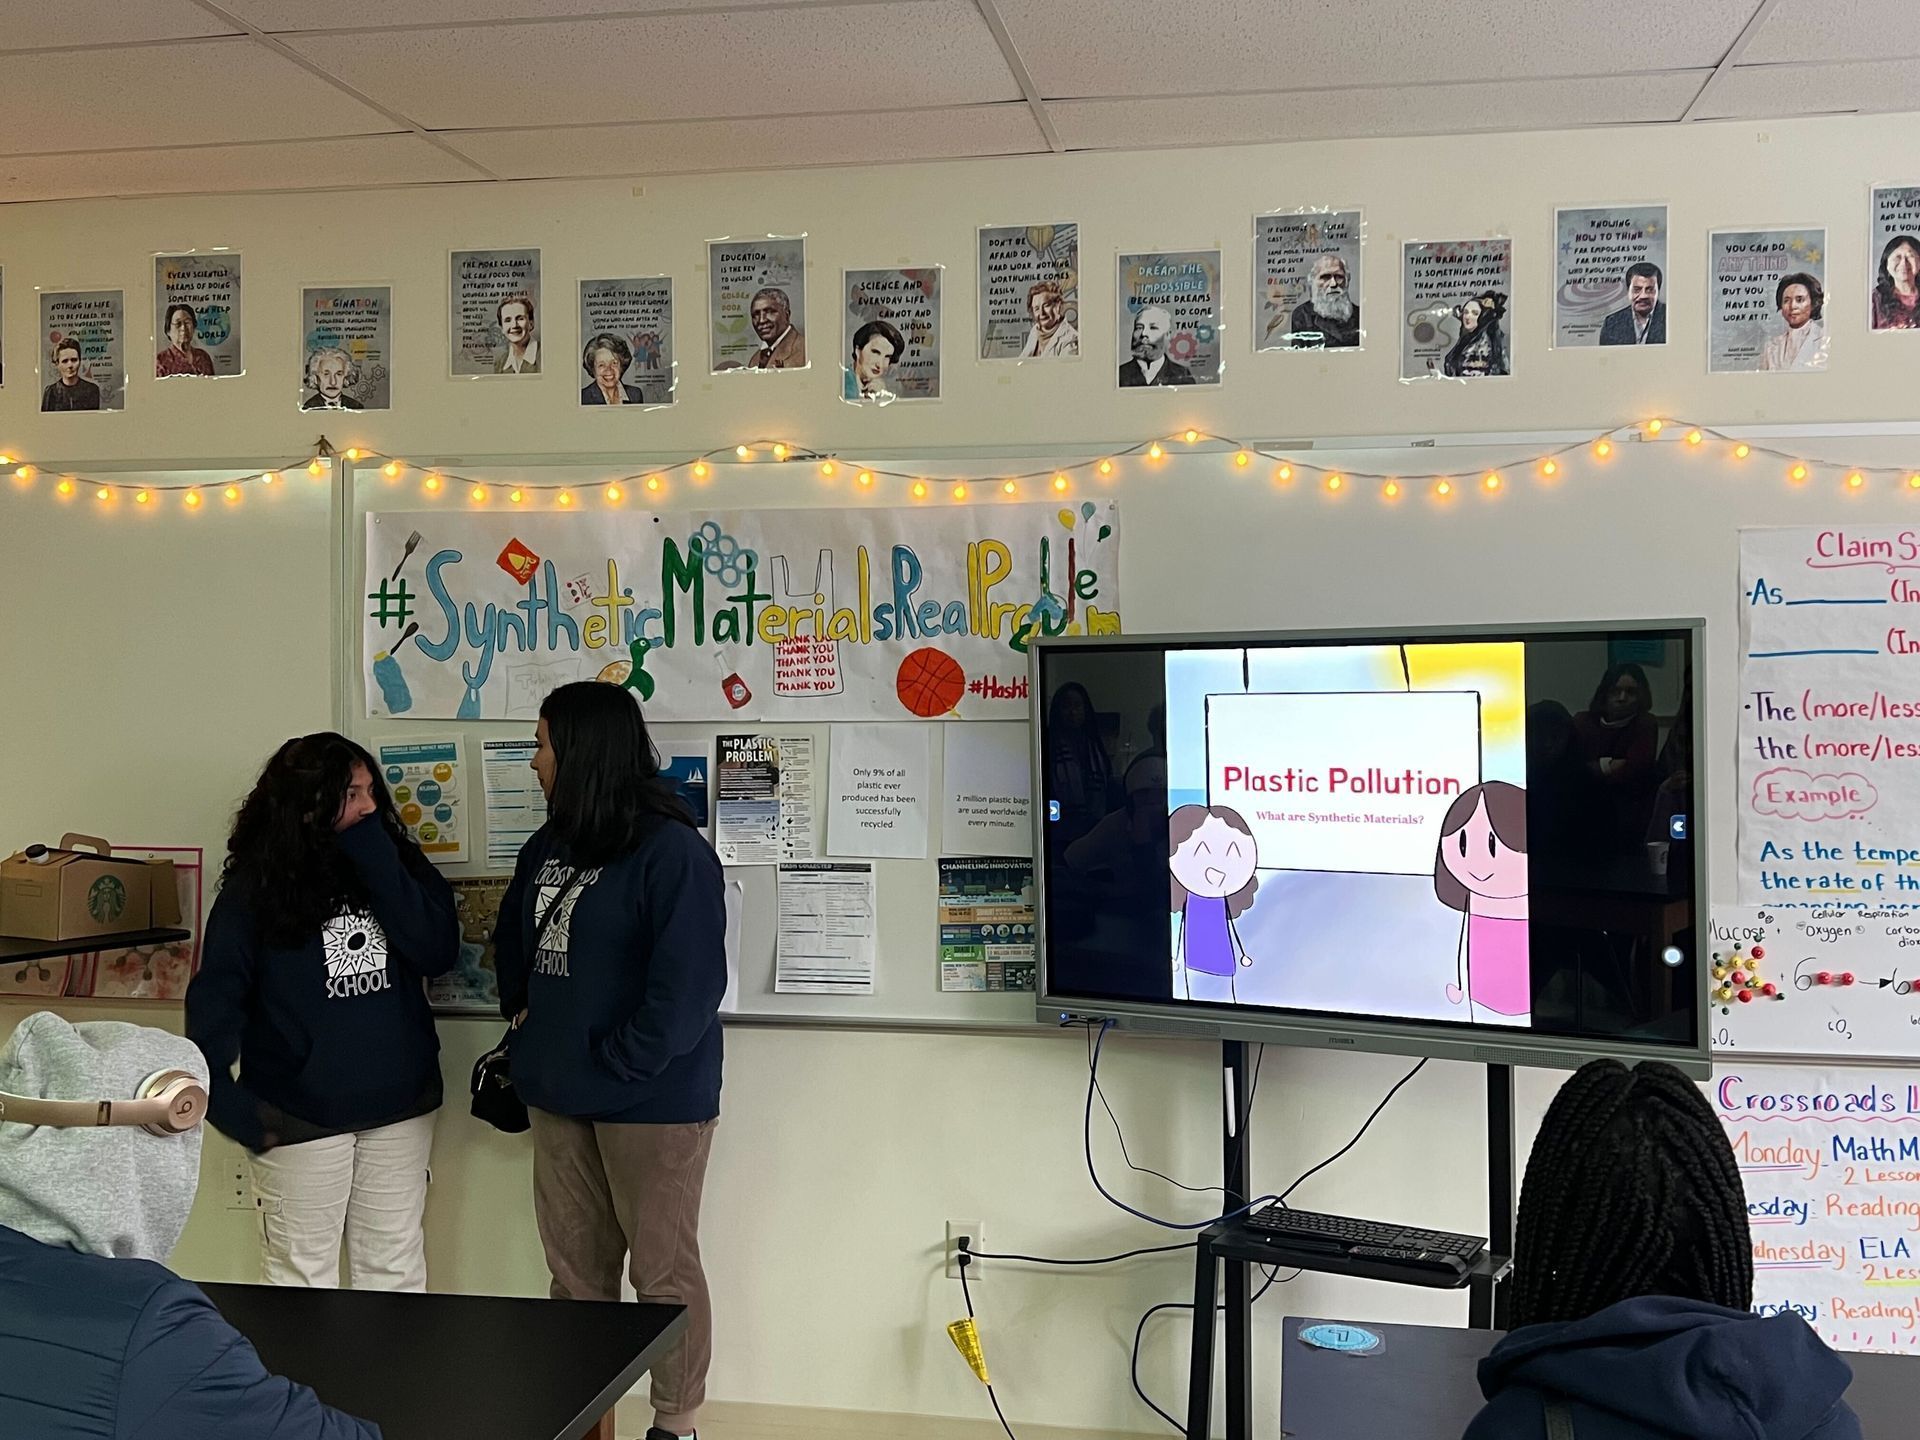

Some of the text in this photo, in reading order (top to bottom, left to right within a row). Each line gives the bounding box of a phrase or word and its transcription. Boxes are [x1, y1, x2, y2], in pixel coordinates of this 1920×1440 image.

[1591, 219, 1631, 228] KNOWING
[1576, 234, 1596, 242] HOW
[1616, 232, 1643, 240] THINK
[1726, 245, 1746, 253] YOU
[721, 253, 766, 261] EDUCATION
[990, 251, 1017, 260] AFRAID
[1410, 256, 1432, 265] THAT
[1719, 255, 1788, 272] ANYTHING
[193, 270, 228, 278] SCIENTIST
[1139, 264, 1202, 276] DREAM THE
[1425, 268, 1473, 277] SOMETHING
[1740, 274, 1763, 282] WANT
[167, 283, 194, 291] DREAMS
[861, 281, 922, 291] SCIENCE AND
[1141, 281, 1203, 293] IMPOSSIBLE
[859, 296, 924, 305] EVERYDAY LIFE
[1131, 294, 1210, 304] BECAUSE DREAMS
[1725, 301, 1749, 309] HAVE
[879, 310, 911, 318] CANNOT
[1189, 307, 1212, 315] COME
[1176, 321, 1199, 330] TRUE
[198, 331, 226, 339] WORLD
[909, 336, 925, 345] NOT
[1817, 532, 1893, 558] Claim
[1752, 578, 1783, 605] As
[776, 644, 833, 655] THANK YOU
[776, 655, 834, 667] THANK YOU
[776, 668, 835, 678] THANK YOU
[776, 681, 835, 691] THANK YOU
[1751, 692, 1796, 721] The
[734, 738, 772, 749] PLASTIC
[1754, 734, 1920, 761] the (more/les
[726, 751, 773, 762] PROBLEM
[853, 768, 871, 777] Only
[857, 781, 881, 789] plastic
[1224, 766, 1461, 795] Plastic Pollution
[1767, 783, 1861, 805] Example
[989, 796, 1011, 804] plastic
[1013, 797, 1029, 805] bags
[856, 807, 901, 816] successfully
[1257, 811, 1424, 824] What are Synthetic Materials?
[861, 821, 893, 829] recycled
[1760, 841, 1794, 862] As
[1803, 841, 1845, 860] the
[1760, 871, 1800, 889] the
[1806, 872, 1855, 889] rate
[1862, 874, 1884, 891] of
[1858, 911, 1909, 919] Respiration
[1709, 919, 1765, 941] lucose
[1806, 926, 1851, 942] Oxygen
[326, 970, 391, 998] SCHOOL
[1718, 1076, 1895, 1112] Crossroads
[1833, 1135, 1895, 1162] Math
[1843, 1167, 1859, 1185] 2
[1860, 1237, 1910, 1259] ELA
[1863, 1264, 1880, 1281] 2
